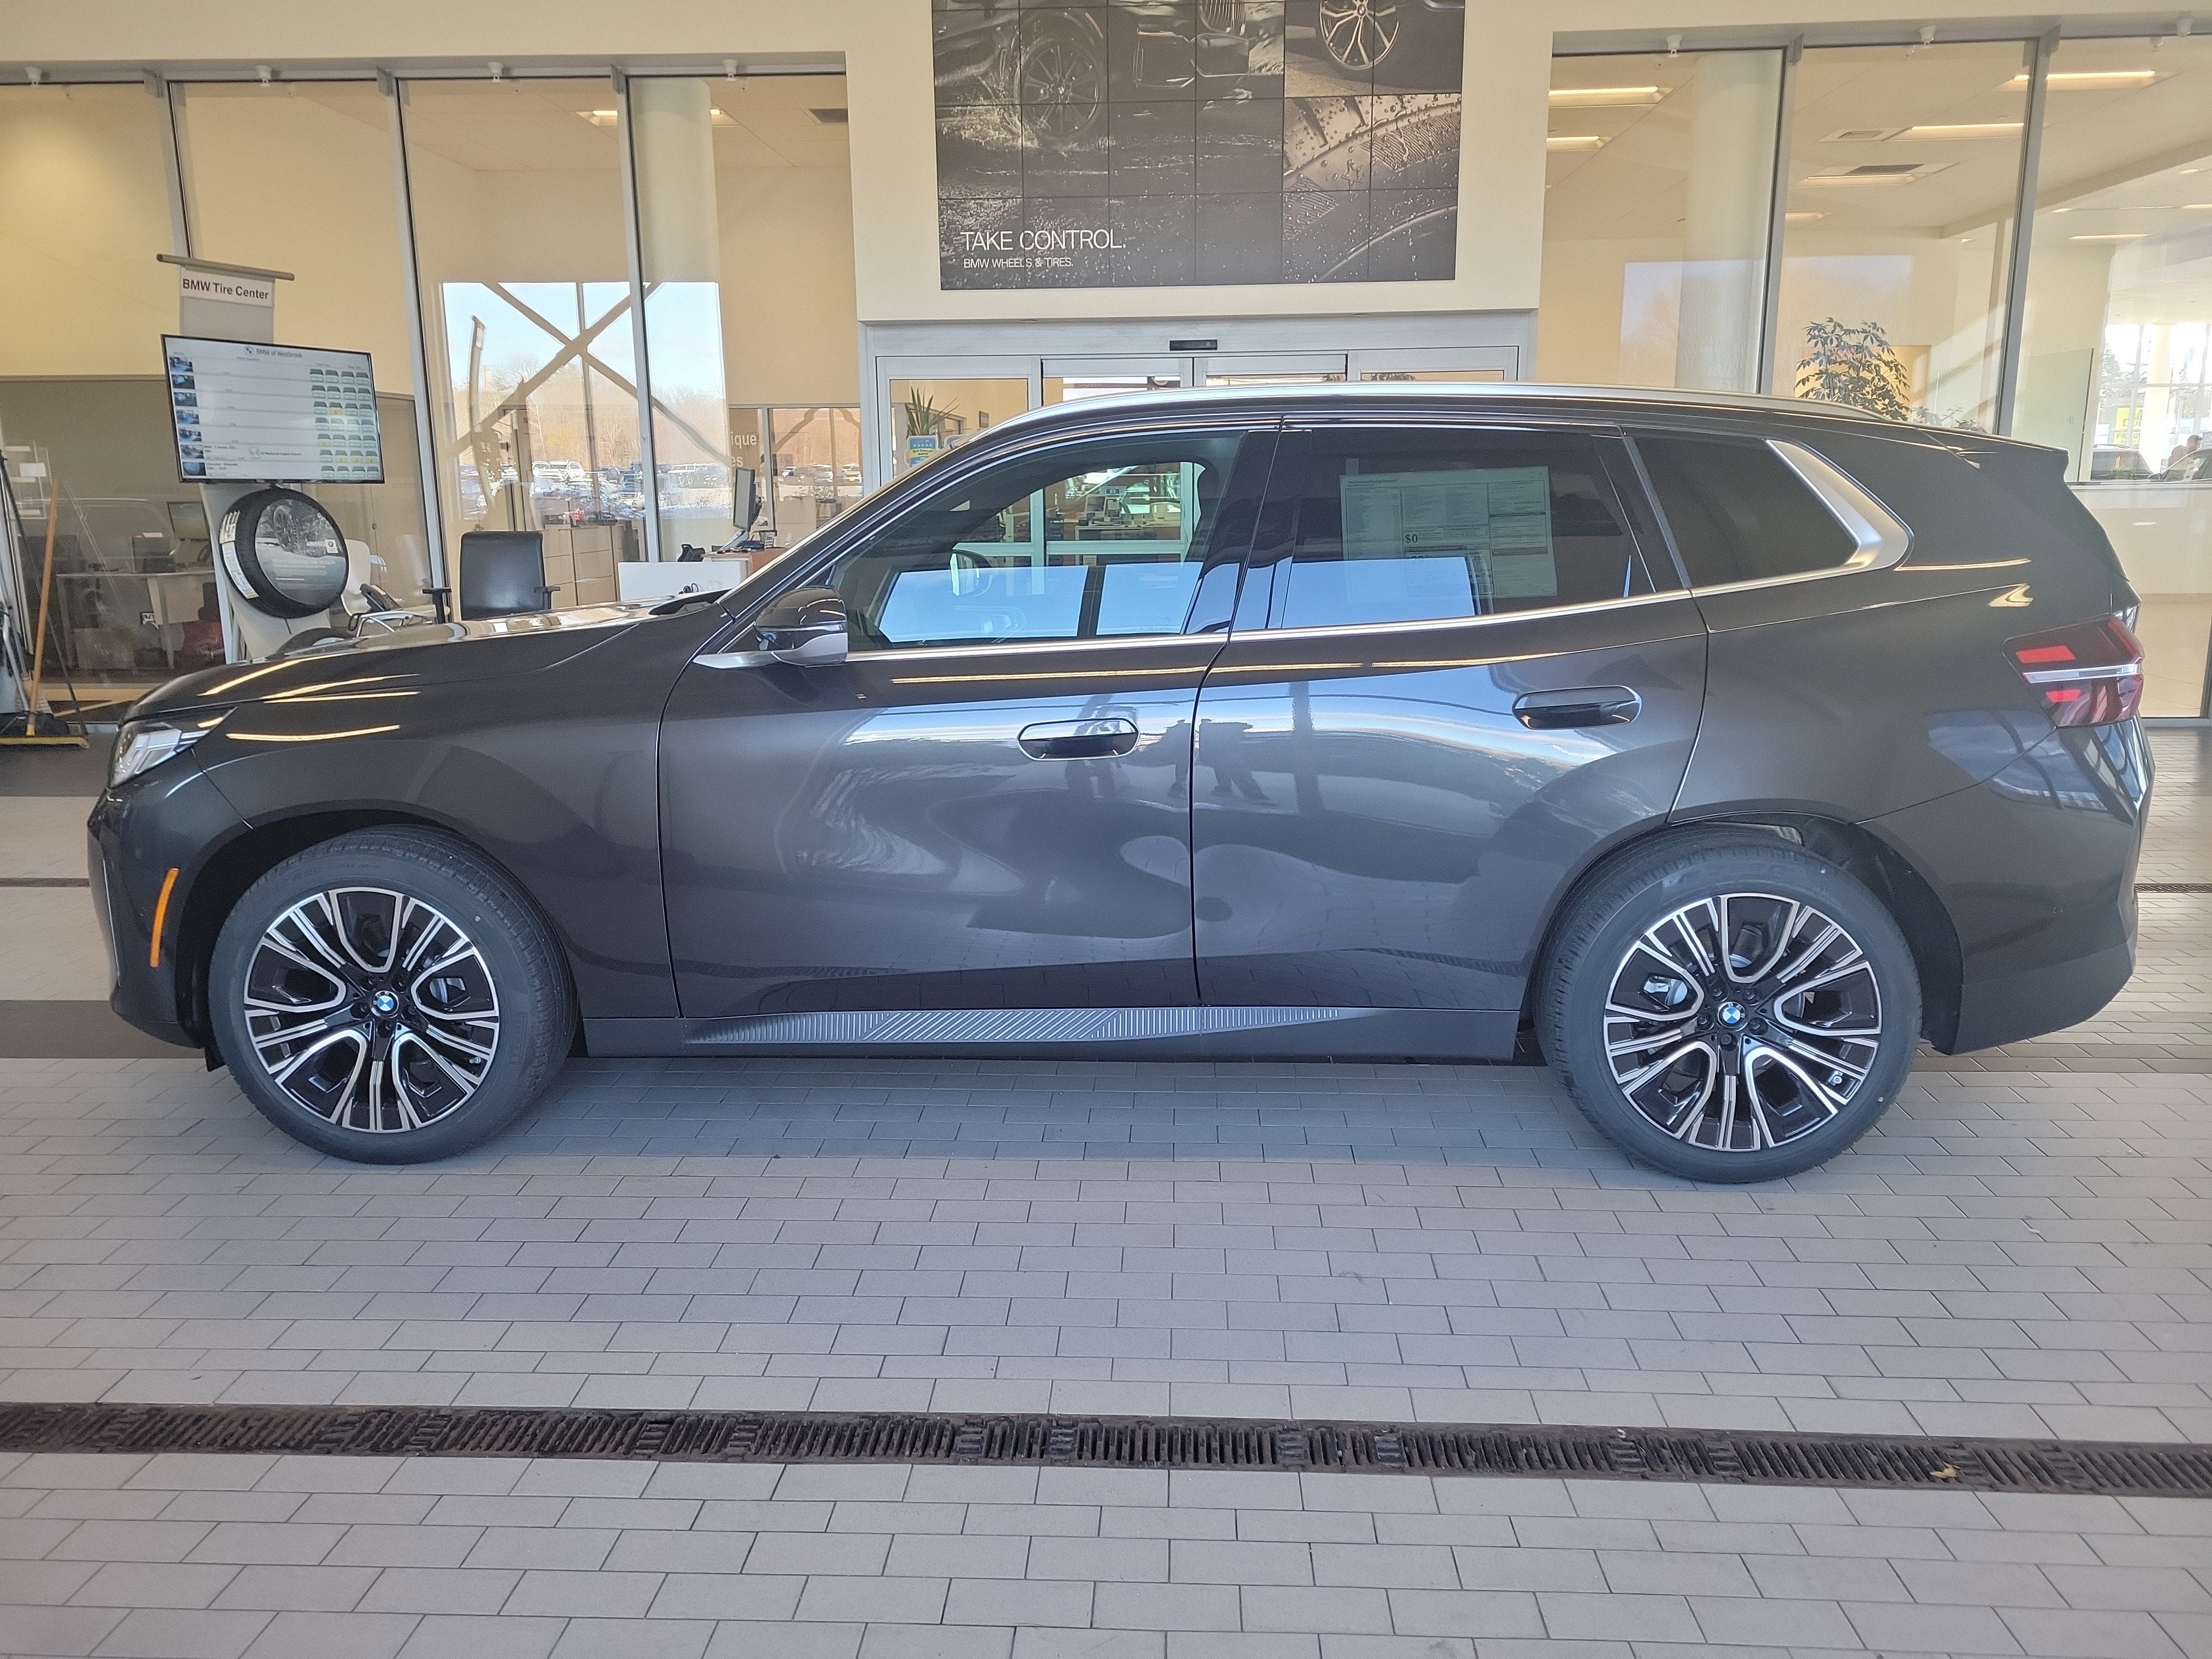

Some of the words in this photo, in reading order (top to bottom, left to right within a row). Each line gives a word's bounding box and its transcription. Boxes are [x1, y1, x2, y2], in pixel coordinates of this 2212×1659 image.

[961, 230, 1014, 251] TAKE
[1019, 229, 1126, 251] CONTROL.
[963, 258, 989, 269] BMW
[991, 257, 1032, 268] WHEELS
[1035, 257, 1042, 268] &
[1045, 257, 1074, 268] TIRES.
[182, 278, 211, 292] BMW
[213, 282, 233, 295] Tire
[235, 285, 269, 300] Center
[1404, 534, 1418, 544] $0
